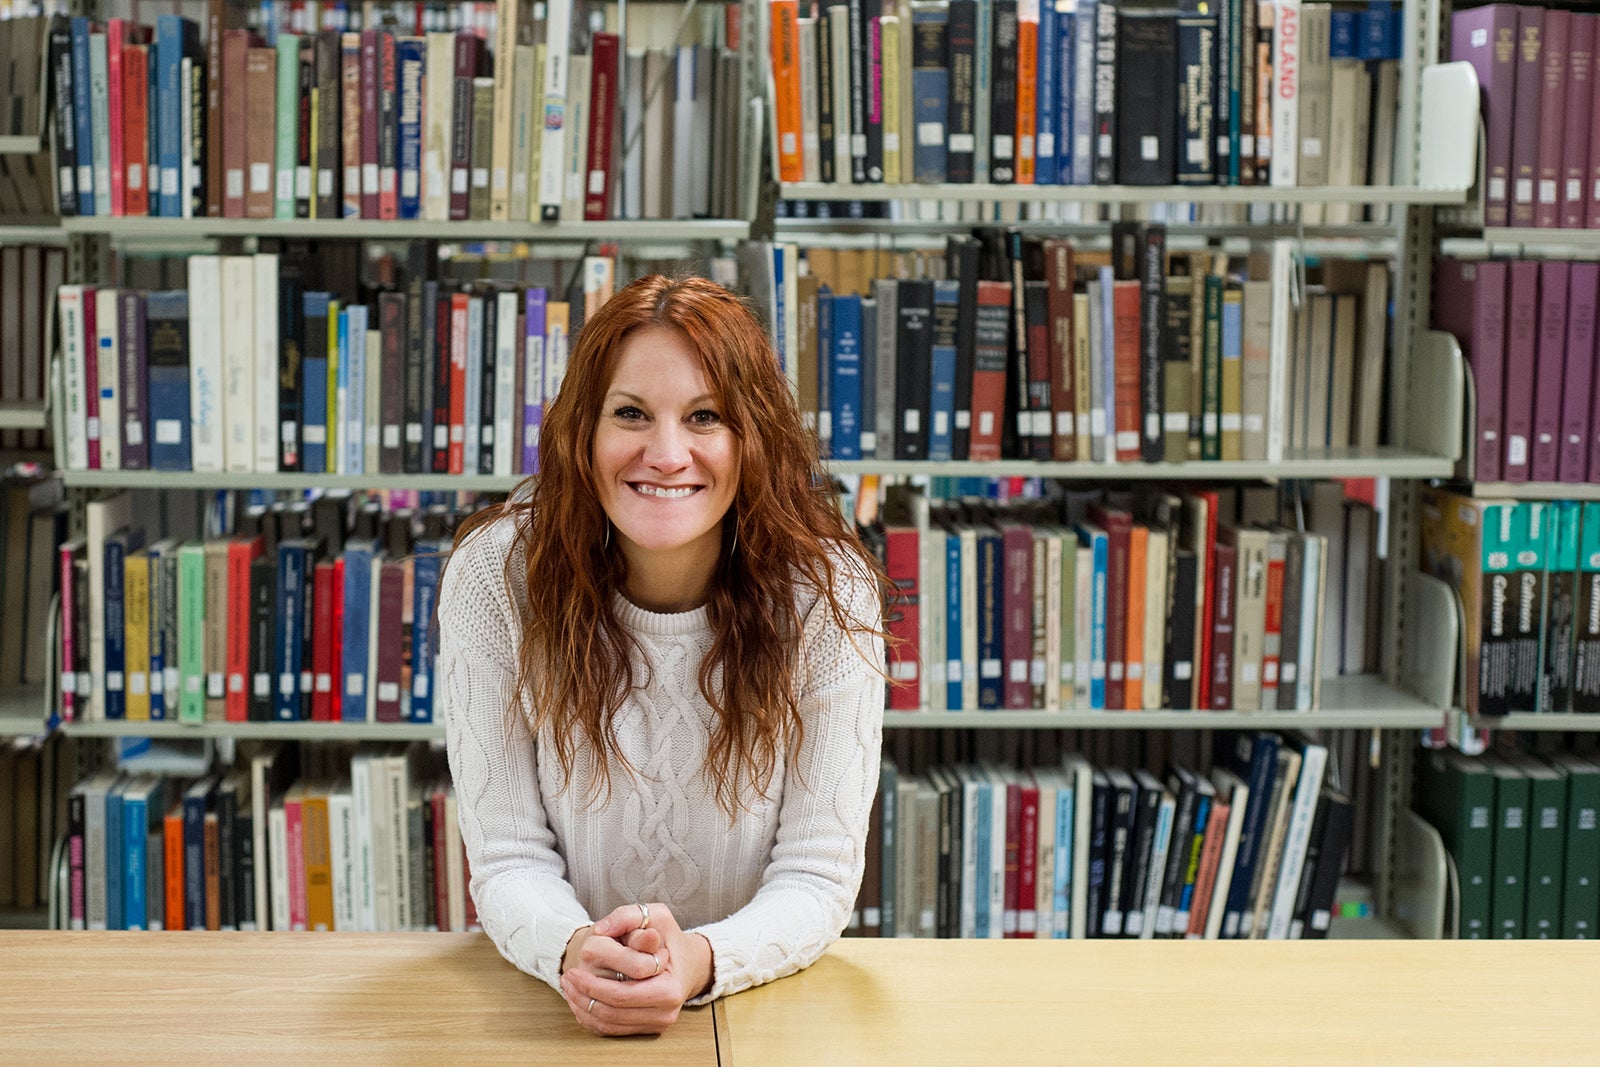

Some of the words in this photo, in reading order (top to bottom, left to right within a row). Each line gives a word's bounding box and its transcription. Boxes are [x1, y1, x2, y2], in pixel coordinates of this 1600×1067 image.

[1097, 3, 1115, 37] ADS
[1097, 40, 1115, 62] TO
[1199, 27, 1213, 102] Advertising
[1279, 6, 1297, 100] ADLAND
[399, 59, 421, 124] Advertising
[1096, 64, 1115, 113] ICONS
